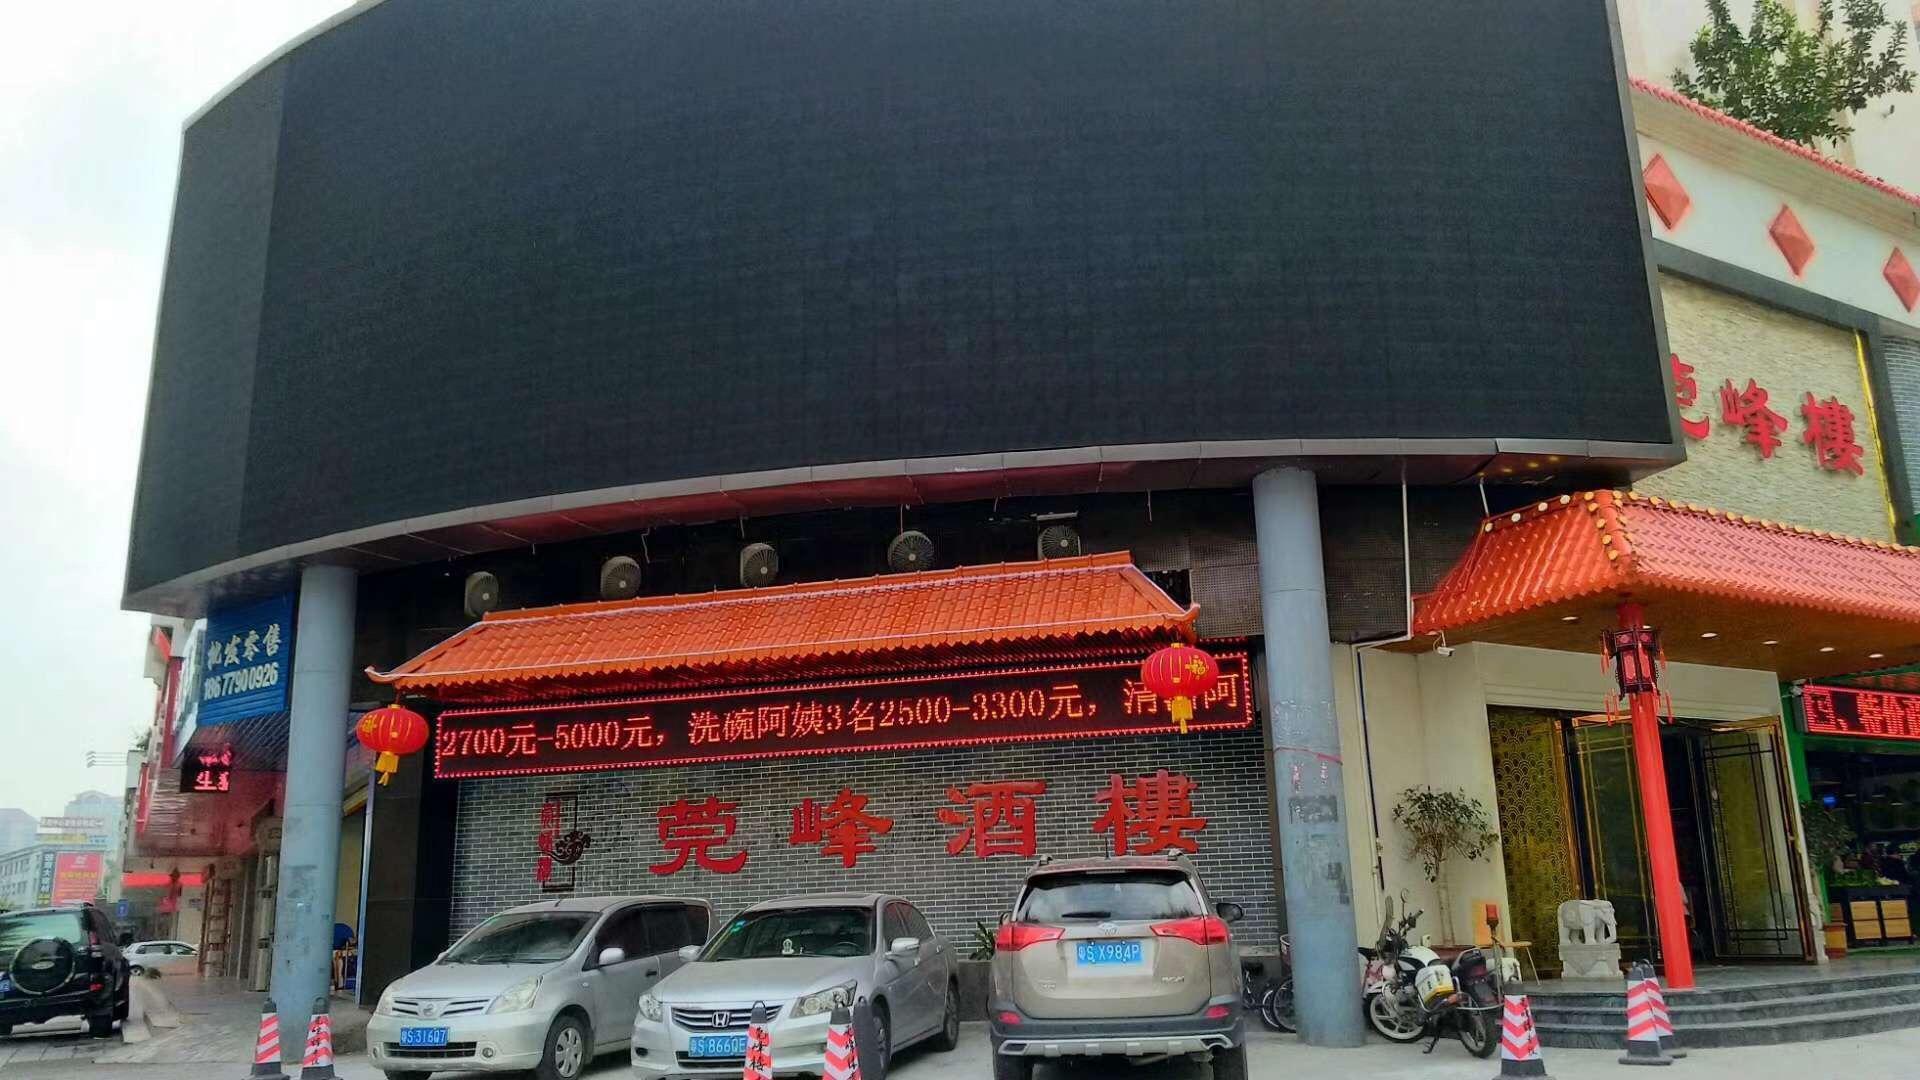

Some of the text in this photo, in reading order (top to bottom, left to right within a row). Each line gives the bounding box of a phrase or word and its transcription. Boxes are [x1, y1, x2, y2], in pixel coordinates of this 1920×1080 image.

[207, 624, 283, 671] 批发零售
[650, 772, 1207, 874] 莞峰酒樓
